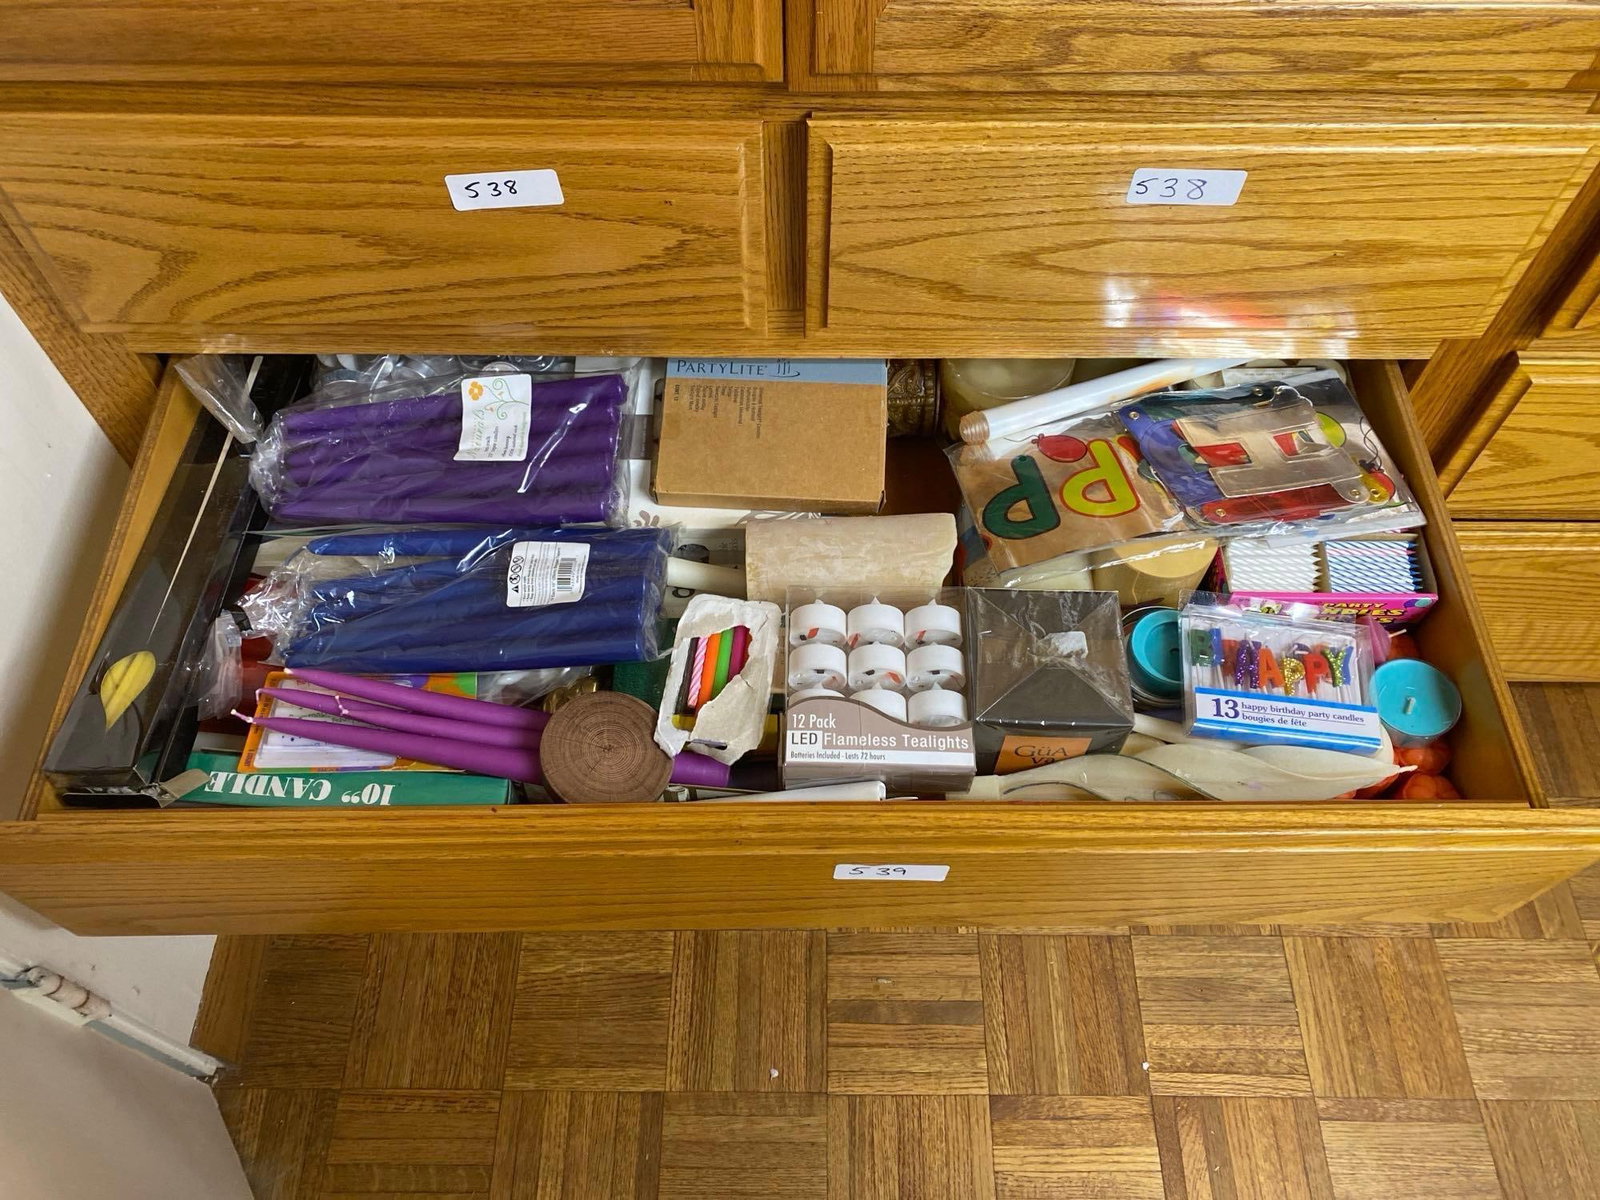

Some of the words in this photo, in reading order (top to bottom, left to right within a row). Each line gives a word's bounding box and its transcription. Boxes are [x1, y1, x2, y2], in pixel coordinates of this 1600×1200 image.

[1135, 178, 1208, 200] 538
[1211, 697, 1240, 719] 13
[1241, 702, 1268, 712] happy
[1270, 705, 1306, 717] birthday
[1308, 711, 1330, 719] party
[1333, 714, 1365, 723] candles
[792, 714, 805, 728] 12
[809, 713, 836, 729] Pack
[1241, 712, 1275, 724] bougies
[1277, 716, 1288, 725] de
[1290, 718, 1308, 727] fête
[791, 732, 818, 745] LED
[824, 732, 897, 747] Flameless
[902, 734, 969, 750] Tealights
[790, 751, 815, 759] Batteries
[816, 752, 840, 760] Included
[845, 752, 859, 760] Lasts
[860, 752, 868, 760] 72
[869, 752, 886, 761] hours
[204, 771, 332, 801] CANDLE
